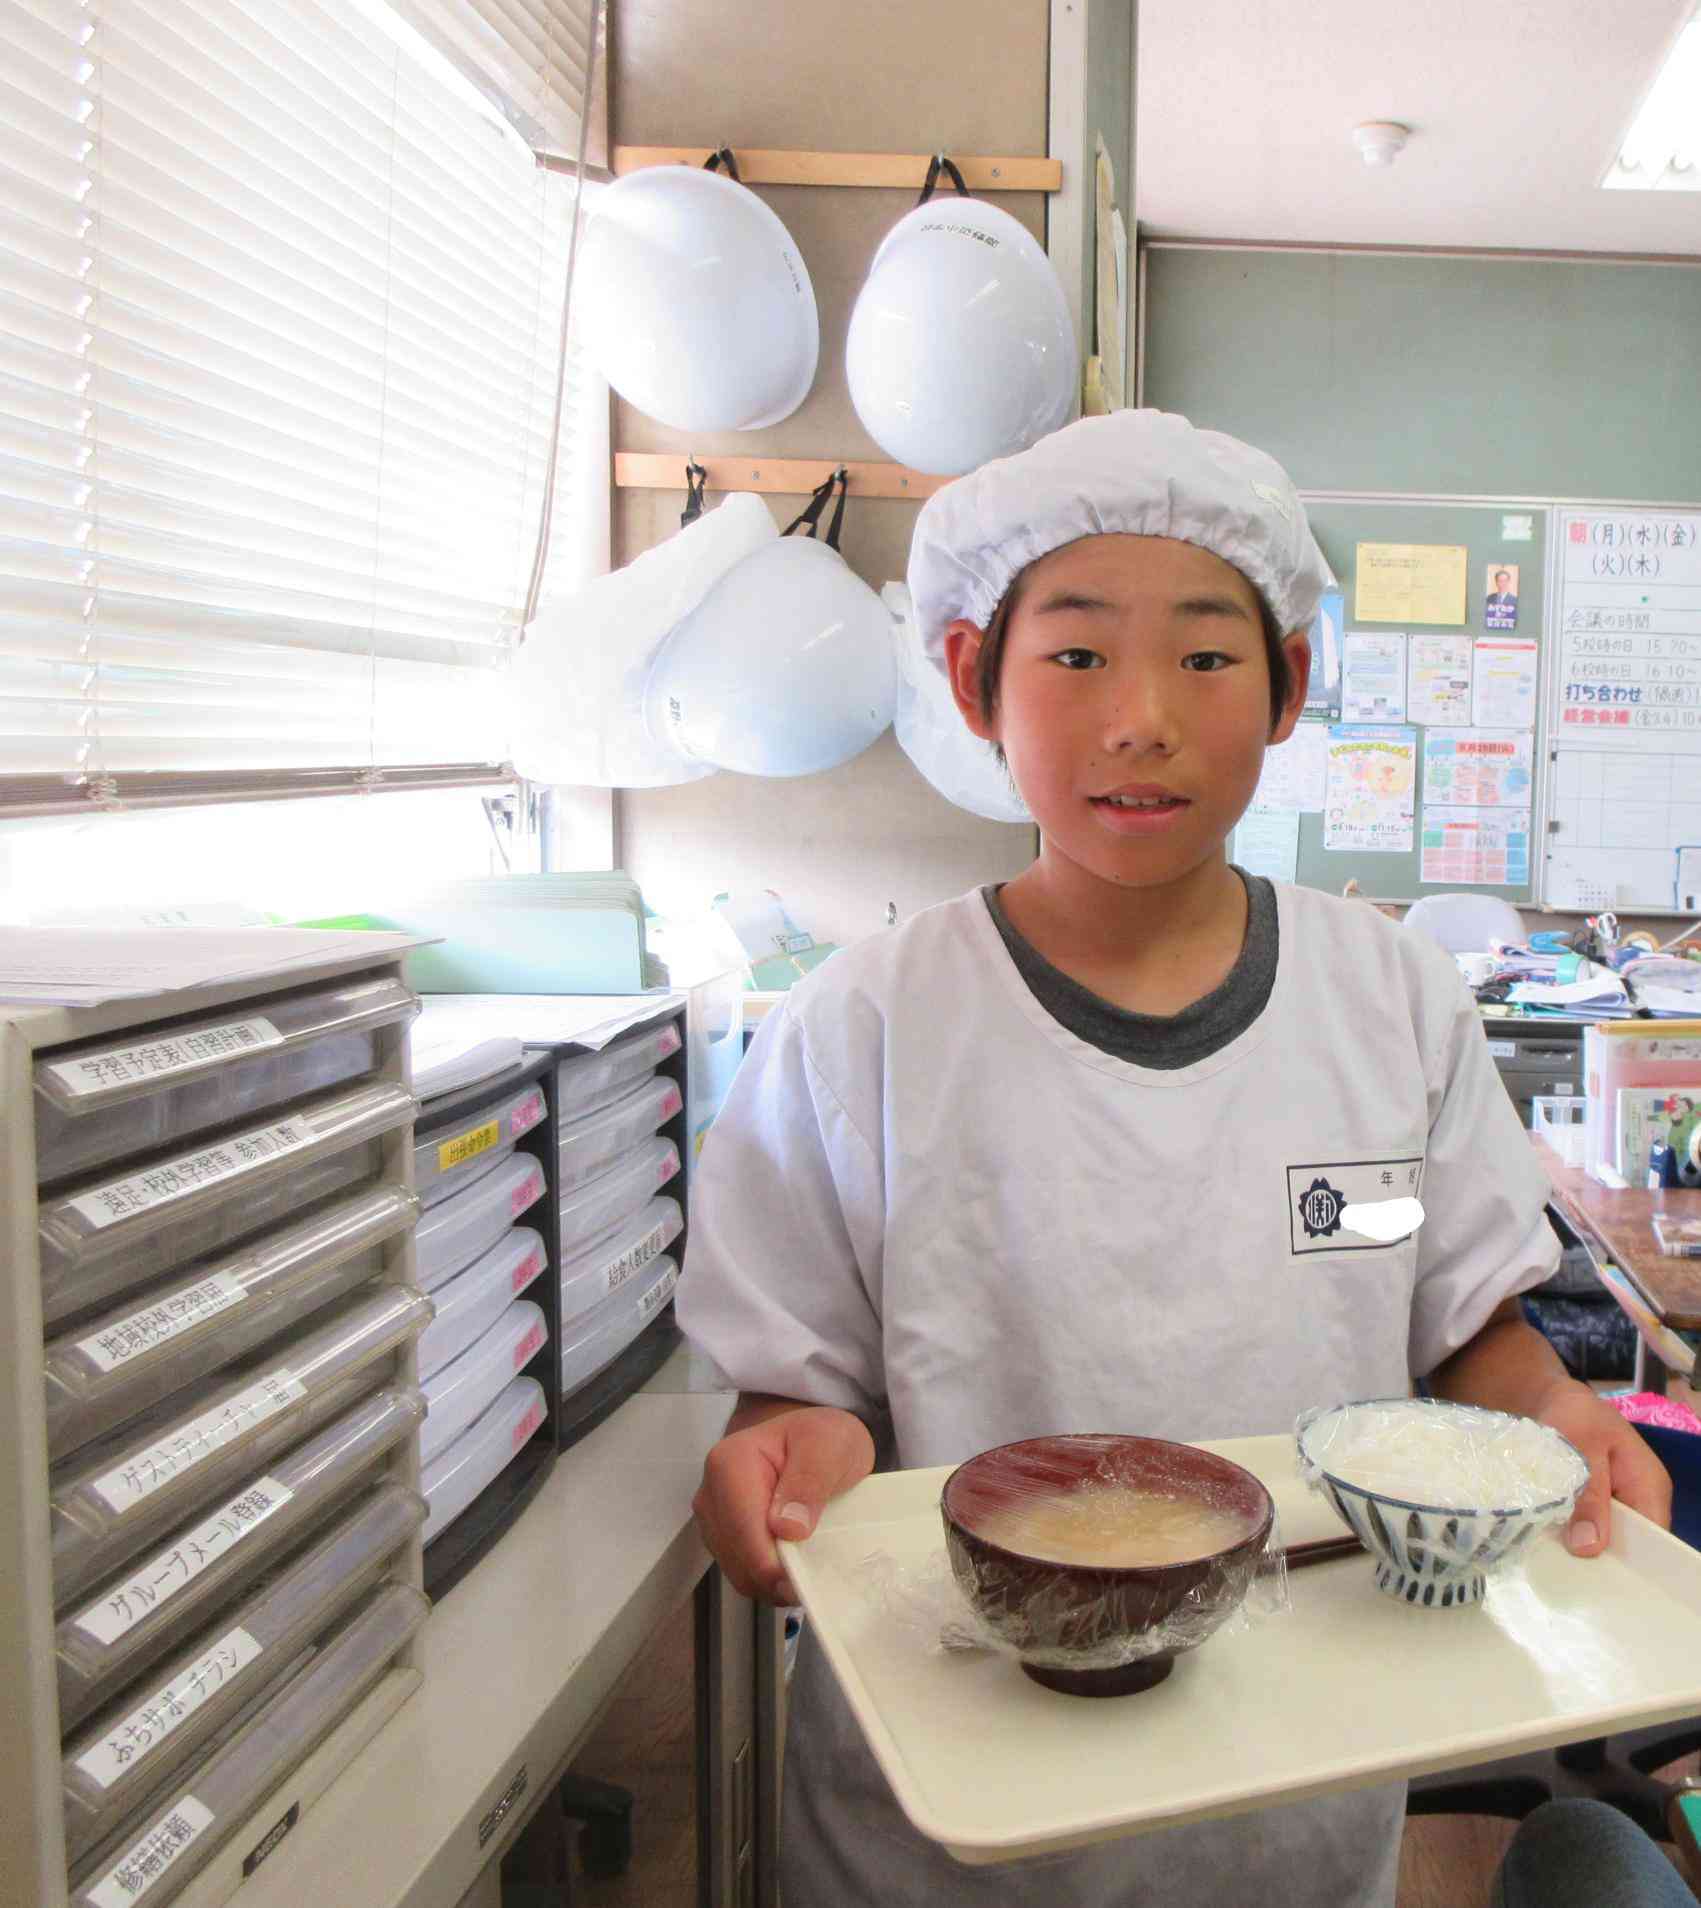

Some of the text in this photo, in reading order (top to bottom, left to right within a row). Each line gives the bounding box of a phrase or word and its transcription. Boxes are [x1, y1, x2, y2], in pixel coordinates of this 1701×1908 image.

[1566, 684, 1642, 702] 打ち合わせ
[1381, 1169, 1395, 1188] 年
[188, 1649, 238, 1697] チラシ
